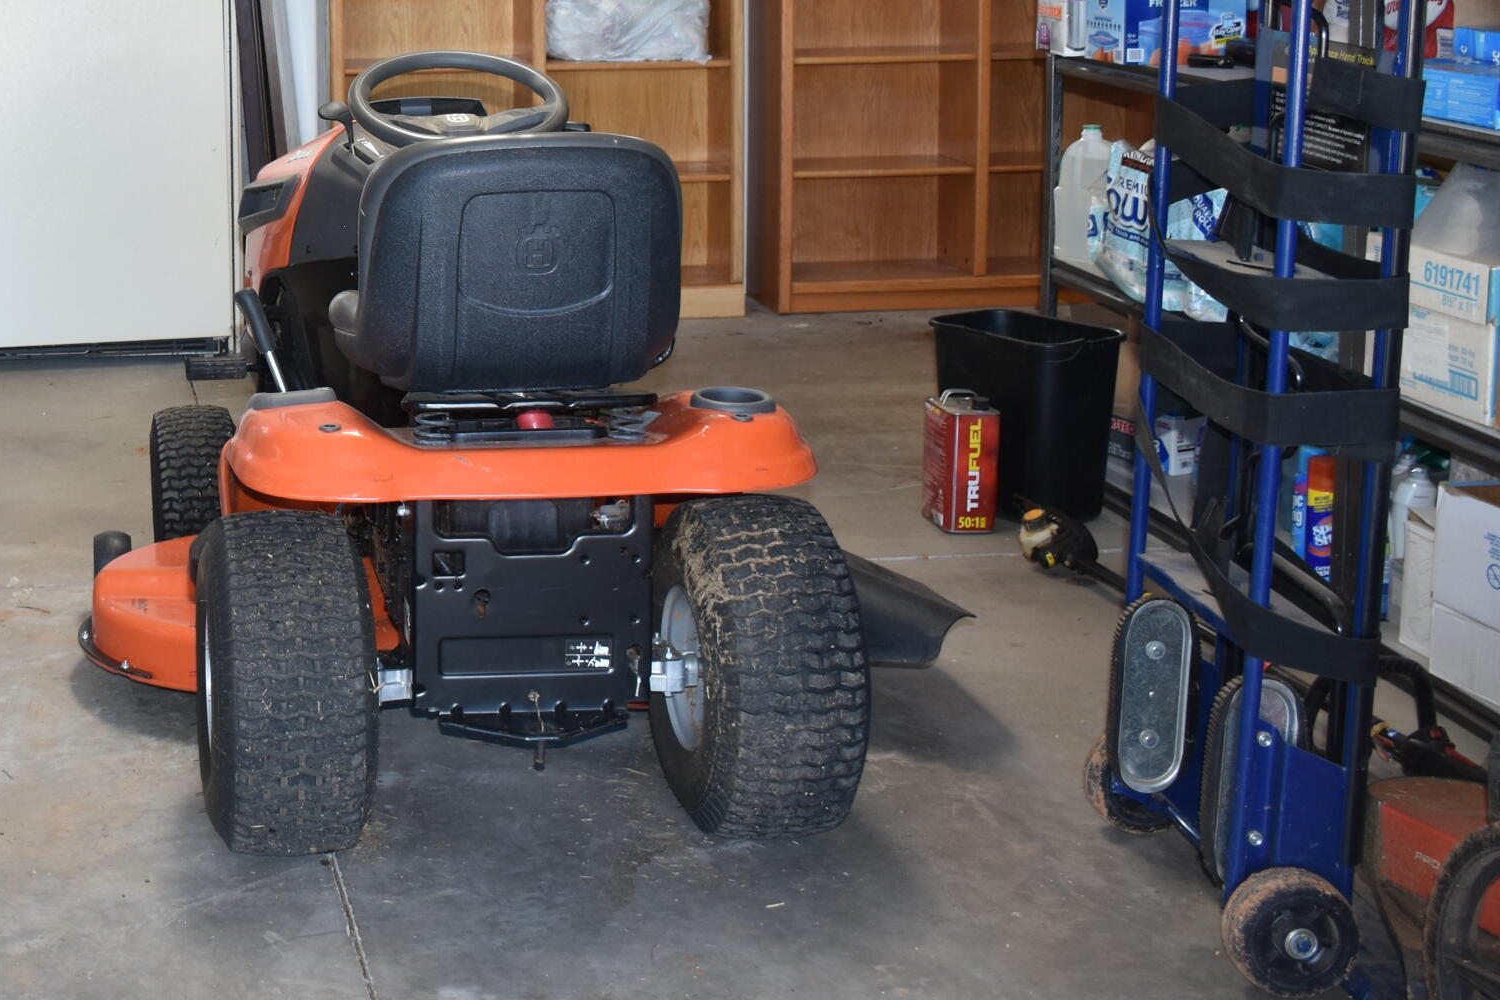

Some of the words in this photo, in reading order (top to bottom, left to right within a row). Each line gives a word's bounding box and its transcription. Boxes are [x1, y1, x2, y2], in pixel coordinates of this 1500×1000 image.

[1340, 50, 1357, 62] Hand
[1357, 53, 1375, 66] Truck
[1123, 150, 1155, 167] KIRKLAN
[1424, 260, 1481, 296] 6191741
[966, 418, 982, 513] TRUFUEL
[958, 516, 979, 529] 50:1
[1415, 851, 1441, 871] PRO
